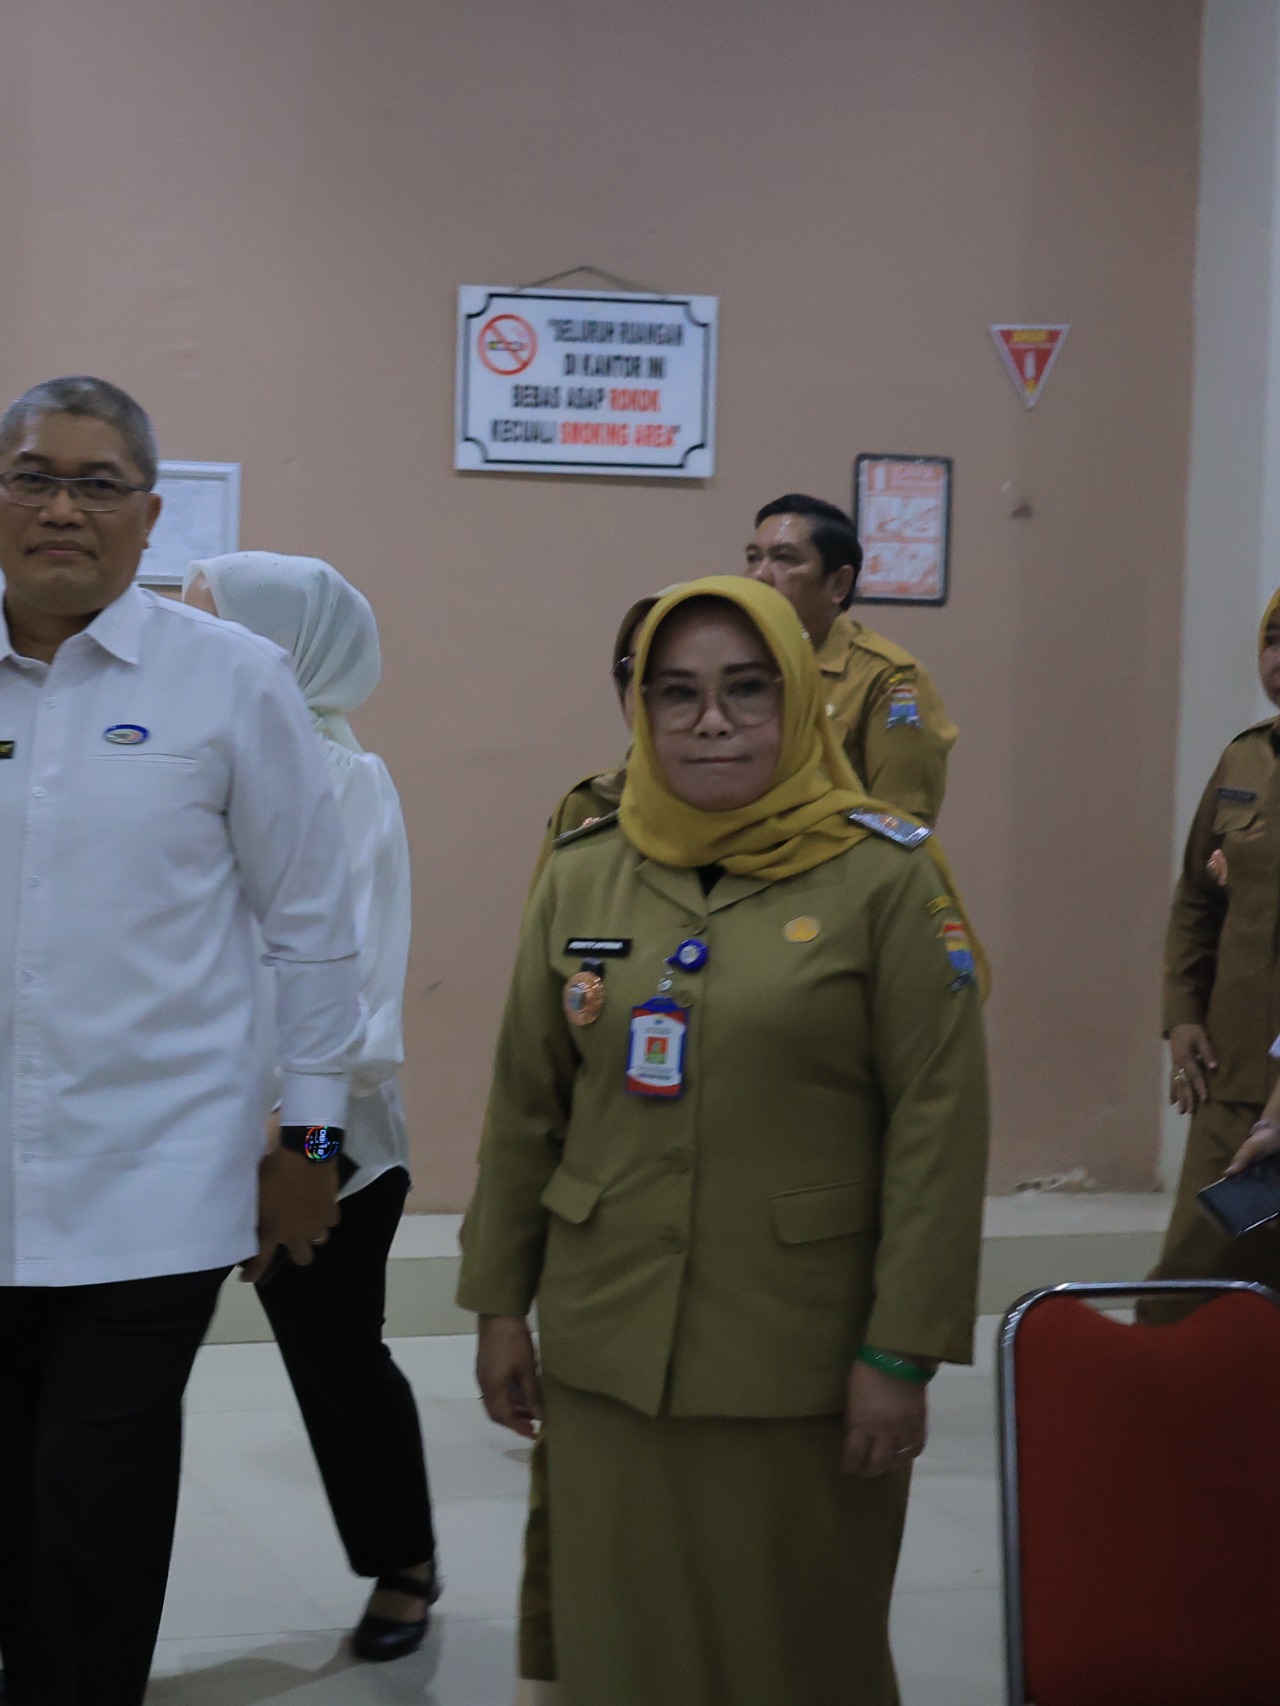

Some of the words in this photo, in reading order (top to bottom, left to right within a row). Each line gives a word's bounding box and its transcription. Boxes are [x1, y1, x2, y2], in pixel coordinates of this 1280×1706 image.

[582, 354, 641, 378] KANTOR
[512, 384, 561, 409] BEBAS
[566, 387, 605, 411] ASAP
[610, 388, 661, 412] ROKOK
[490, 419, 556, 444] KECUALI
[561, 422, 630, 446] SMOKING
